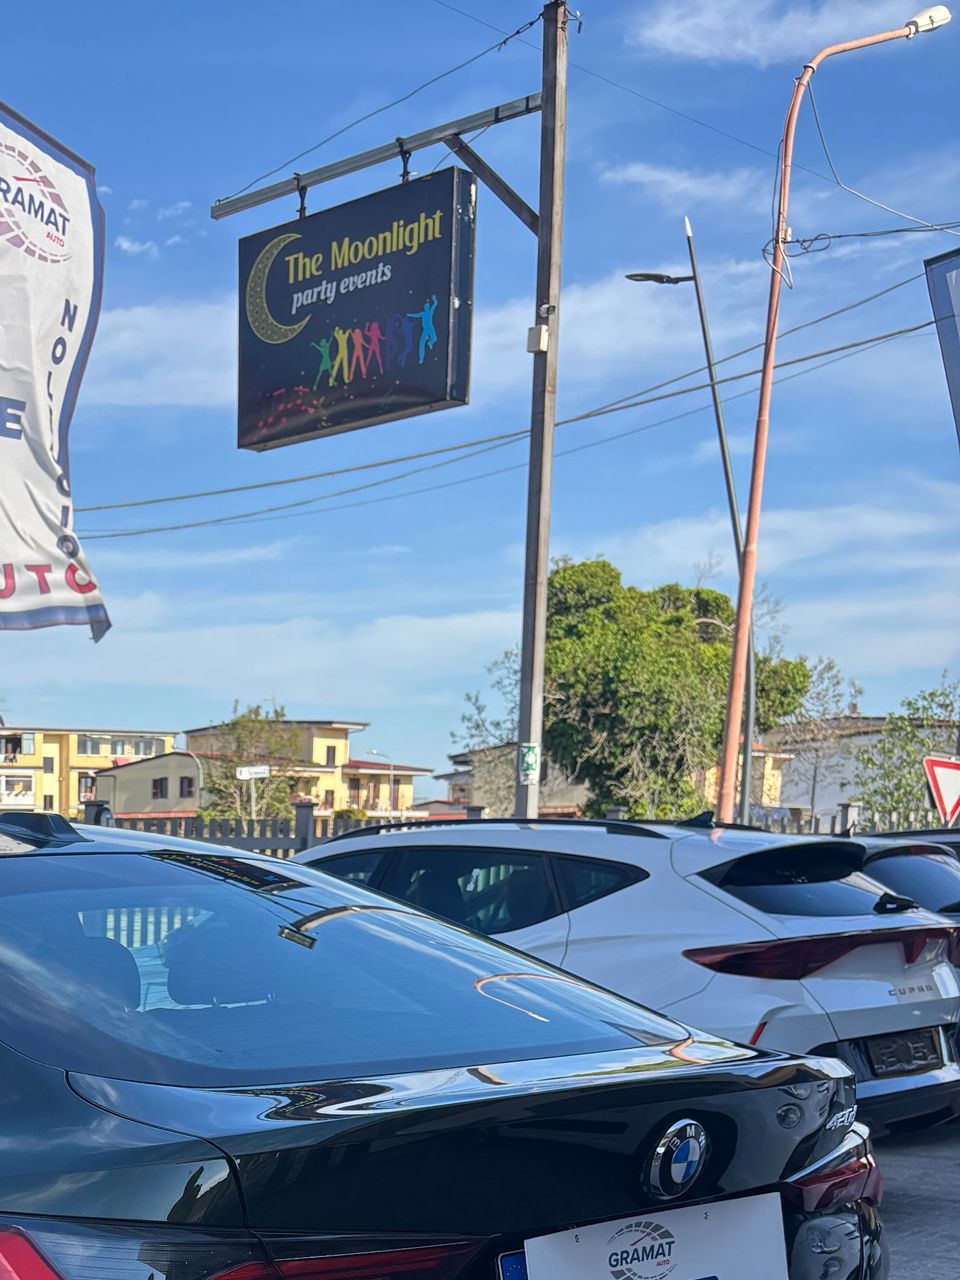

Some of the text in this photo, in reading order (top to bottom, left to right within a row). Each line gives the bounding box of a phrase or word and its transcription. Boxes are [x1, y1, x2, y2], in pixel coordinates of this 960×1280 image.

[46, 231, 65, 247] AUTO
[284, 209, 443, 284] The Moonlight
[291, 262, 392, 315] party events
[669, 1125, 706, 1150] BMW
[608, 1240, 675, 1268] GRAMAT
[655, 1259, 670, 1267] AUTO
